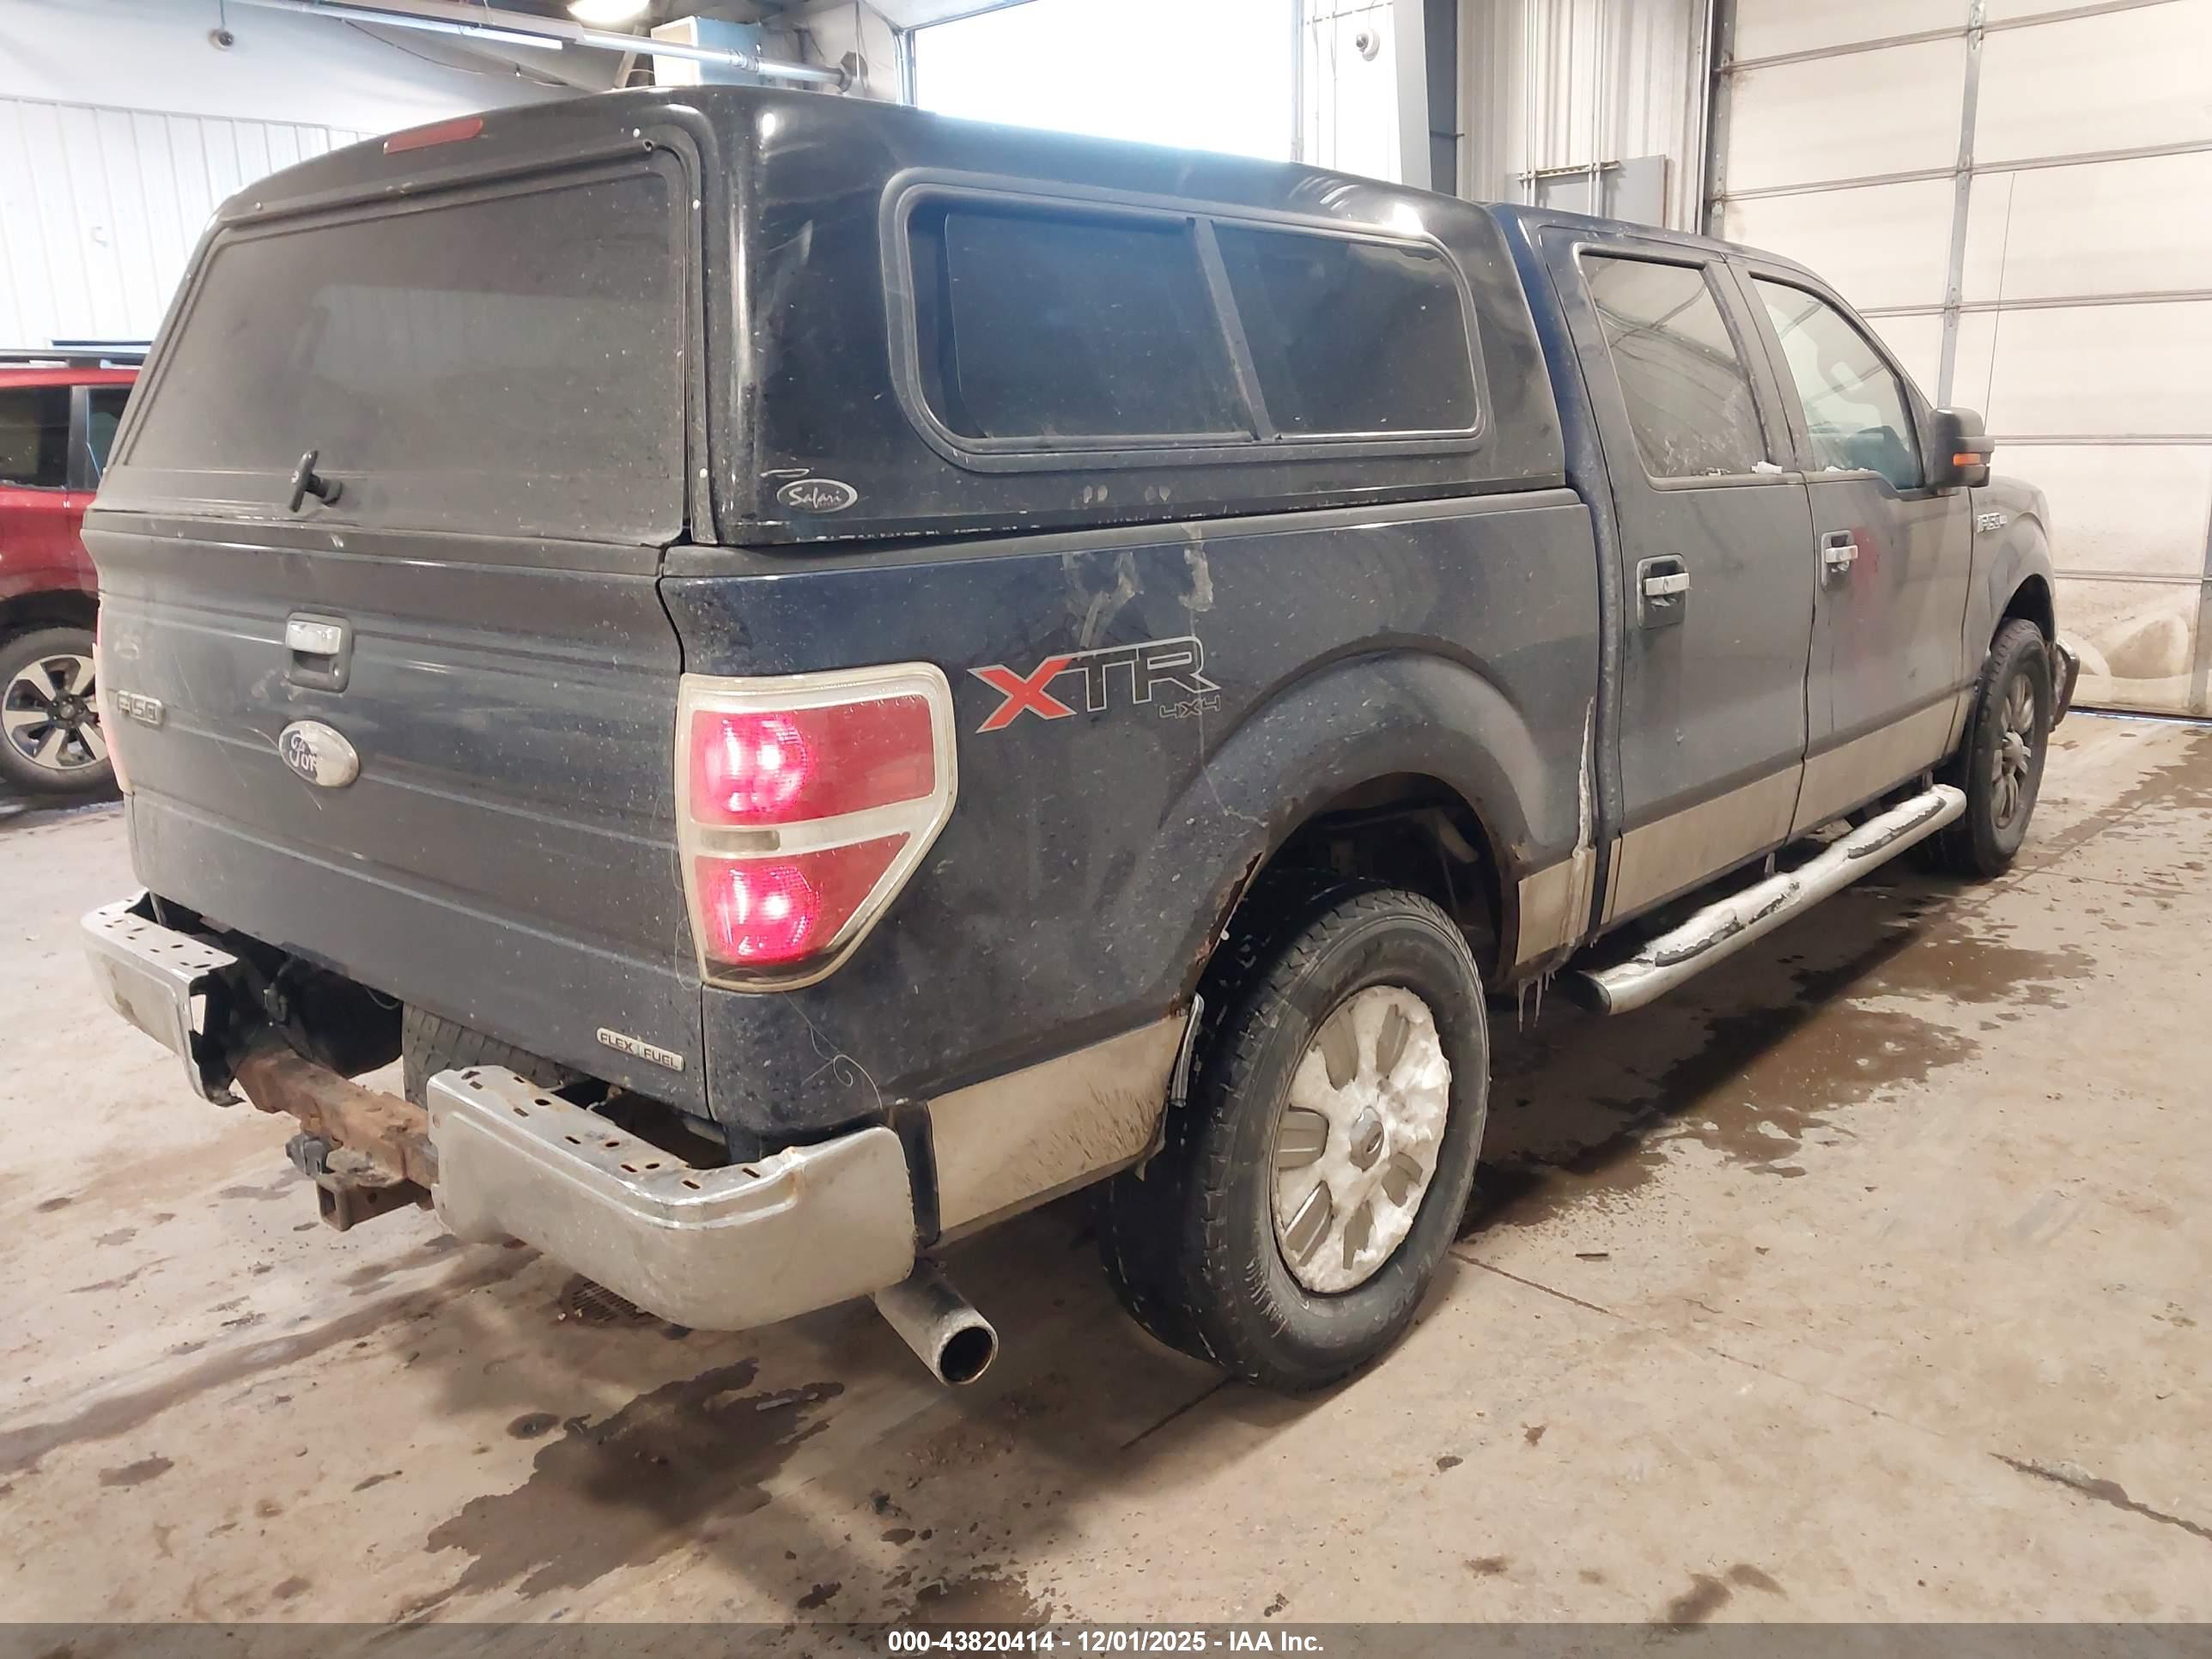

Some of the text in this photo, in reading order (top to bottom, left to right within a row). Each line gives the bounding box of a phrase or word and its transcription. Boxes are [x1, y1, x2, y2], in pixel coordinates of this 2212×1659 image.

[788, 487, 842, 508] Safari
[967, 635, 1220, 733] XTR
[600, 1032, 678, 1068] FLEX FUEL
